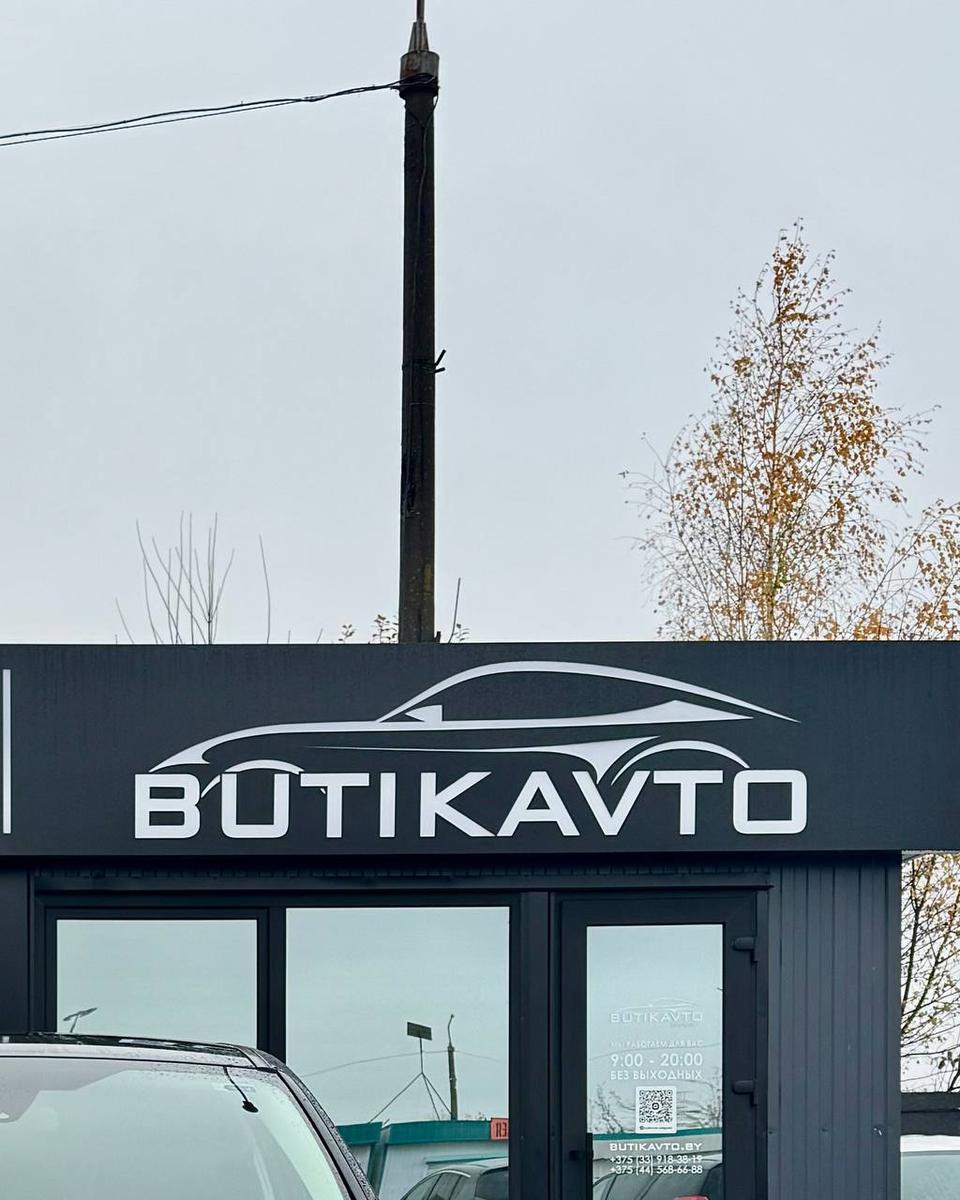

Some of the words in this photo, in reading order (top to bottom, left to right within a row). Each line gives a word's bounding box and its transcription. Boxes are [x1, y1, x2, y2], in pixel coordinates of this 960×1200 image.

[133, 769, 808, 840] BUTIKAVTO
[610, 1053, 643, 1067] 9:00
[660, 1053, 703, 1067] 20:00
[610, 1070, 630, 1081] БЕЗ
[609, 1143, 703, 1151] BUTIKAVTO.BY
[610, 1155, 633, 1164] +375
[636, 1154, 654, 1166] (33)
[656, 1155, 703, 1164] 918-38-19
[610, 1165, 633, 1174] +375
[636, 1165, 654, 1176] (44)
[656, 1165, 703, 1174] 568-66-88
